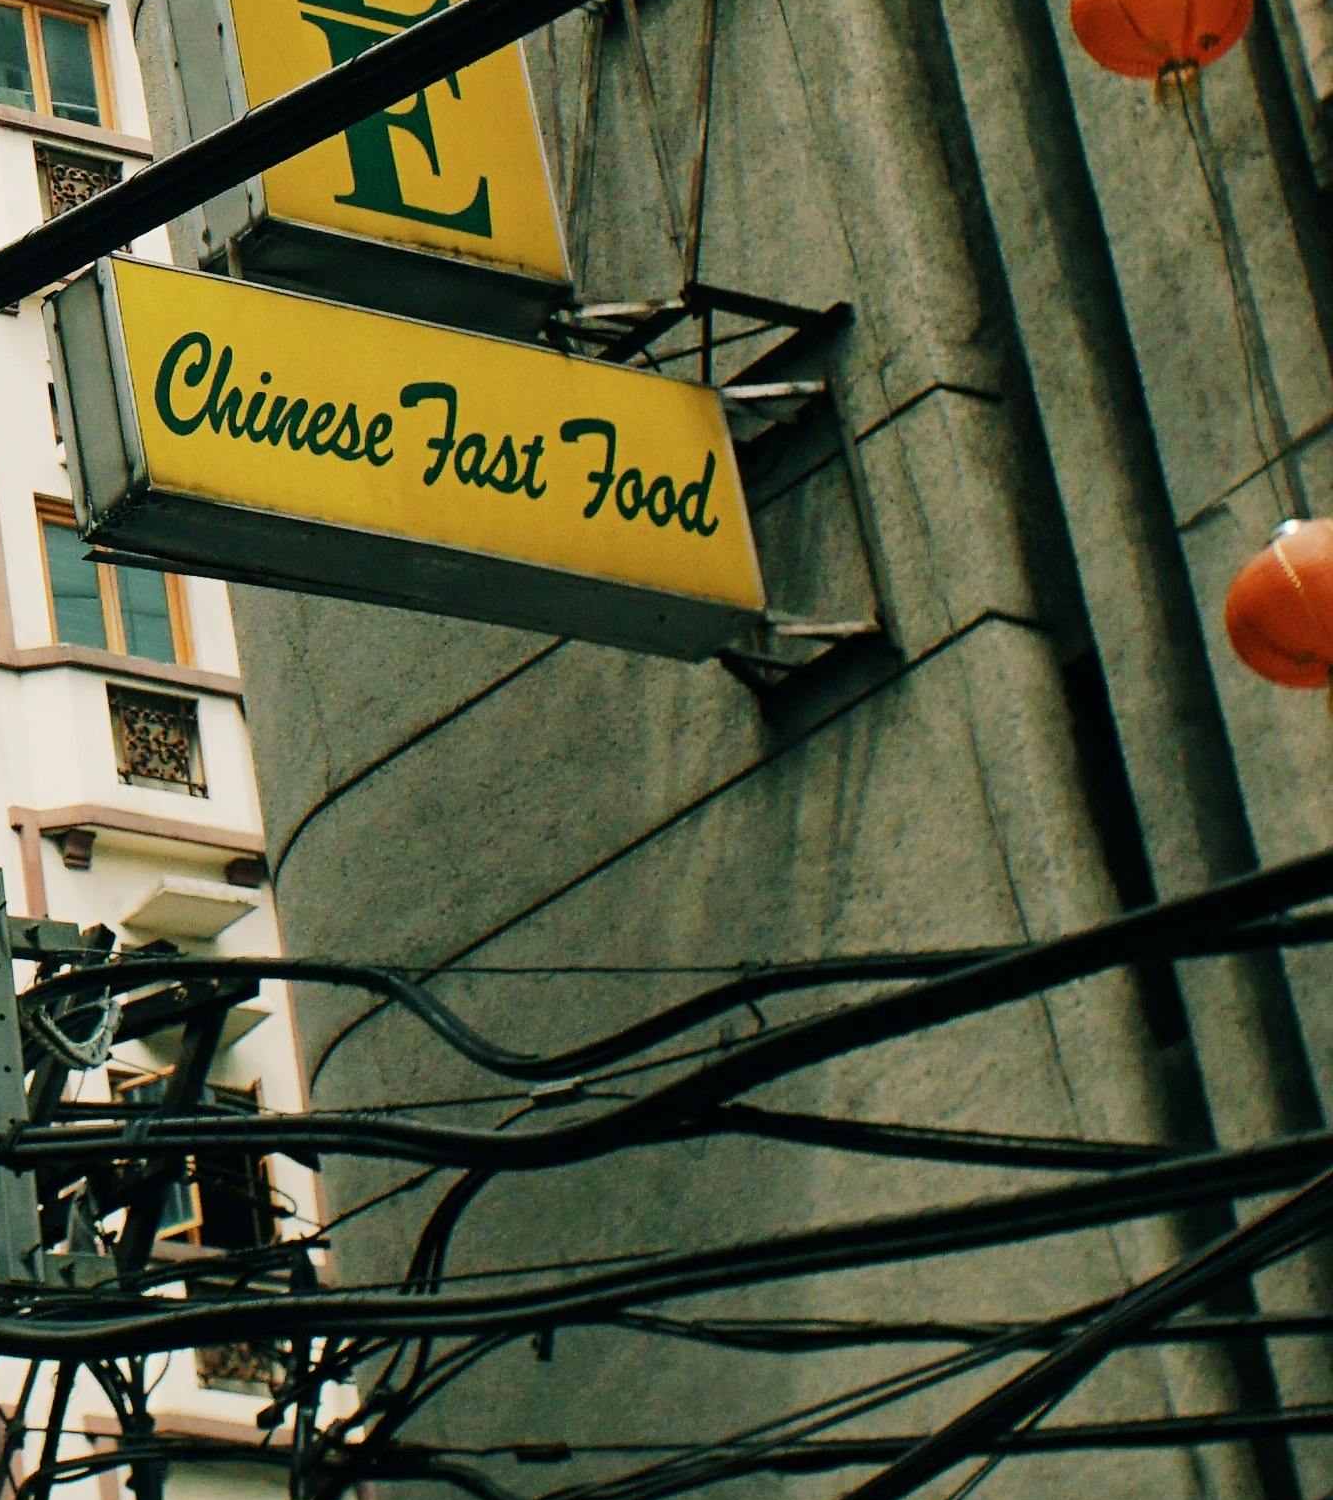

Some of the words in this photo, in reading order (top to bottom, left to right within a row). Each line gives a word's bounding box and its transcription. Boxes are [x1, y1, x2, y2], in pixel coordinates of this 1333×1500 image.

[154, 330, 395, 468] Chinese
[399, 380, 548, 499] Fast
[559, 417, 721, 538] Food
